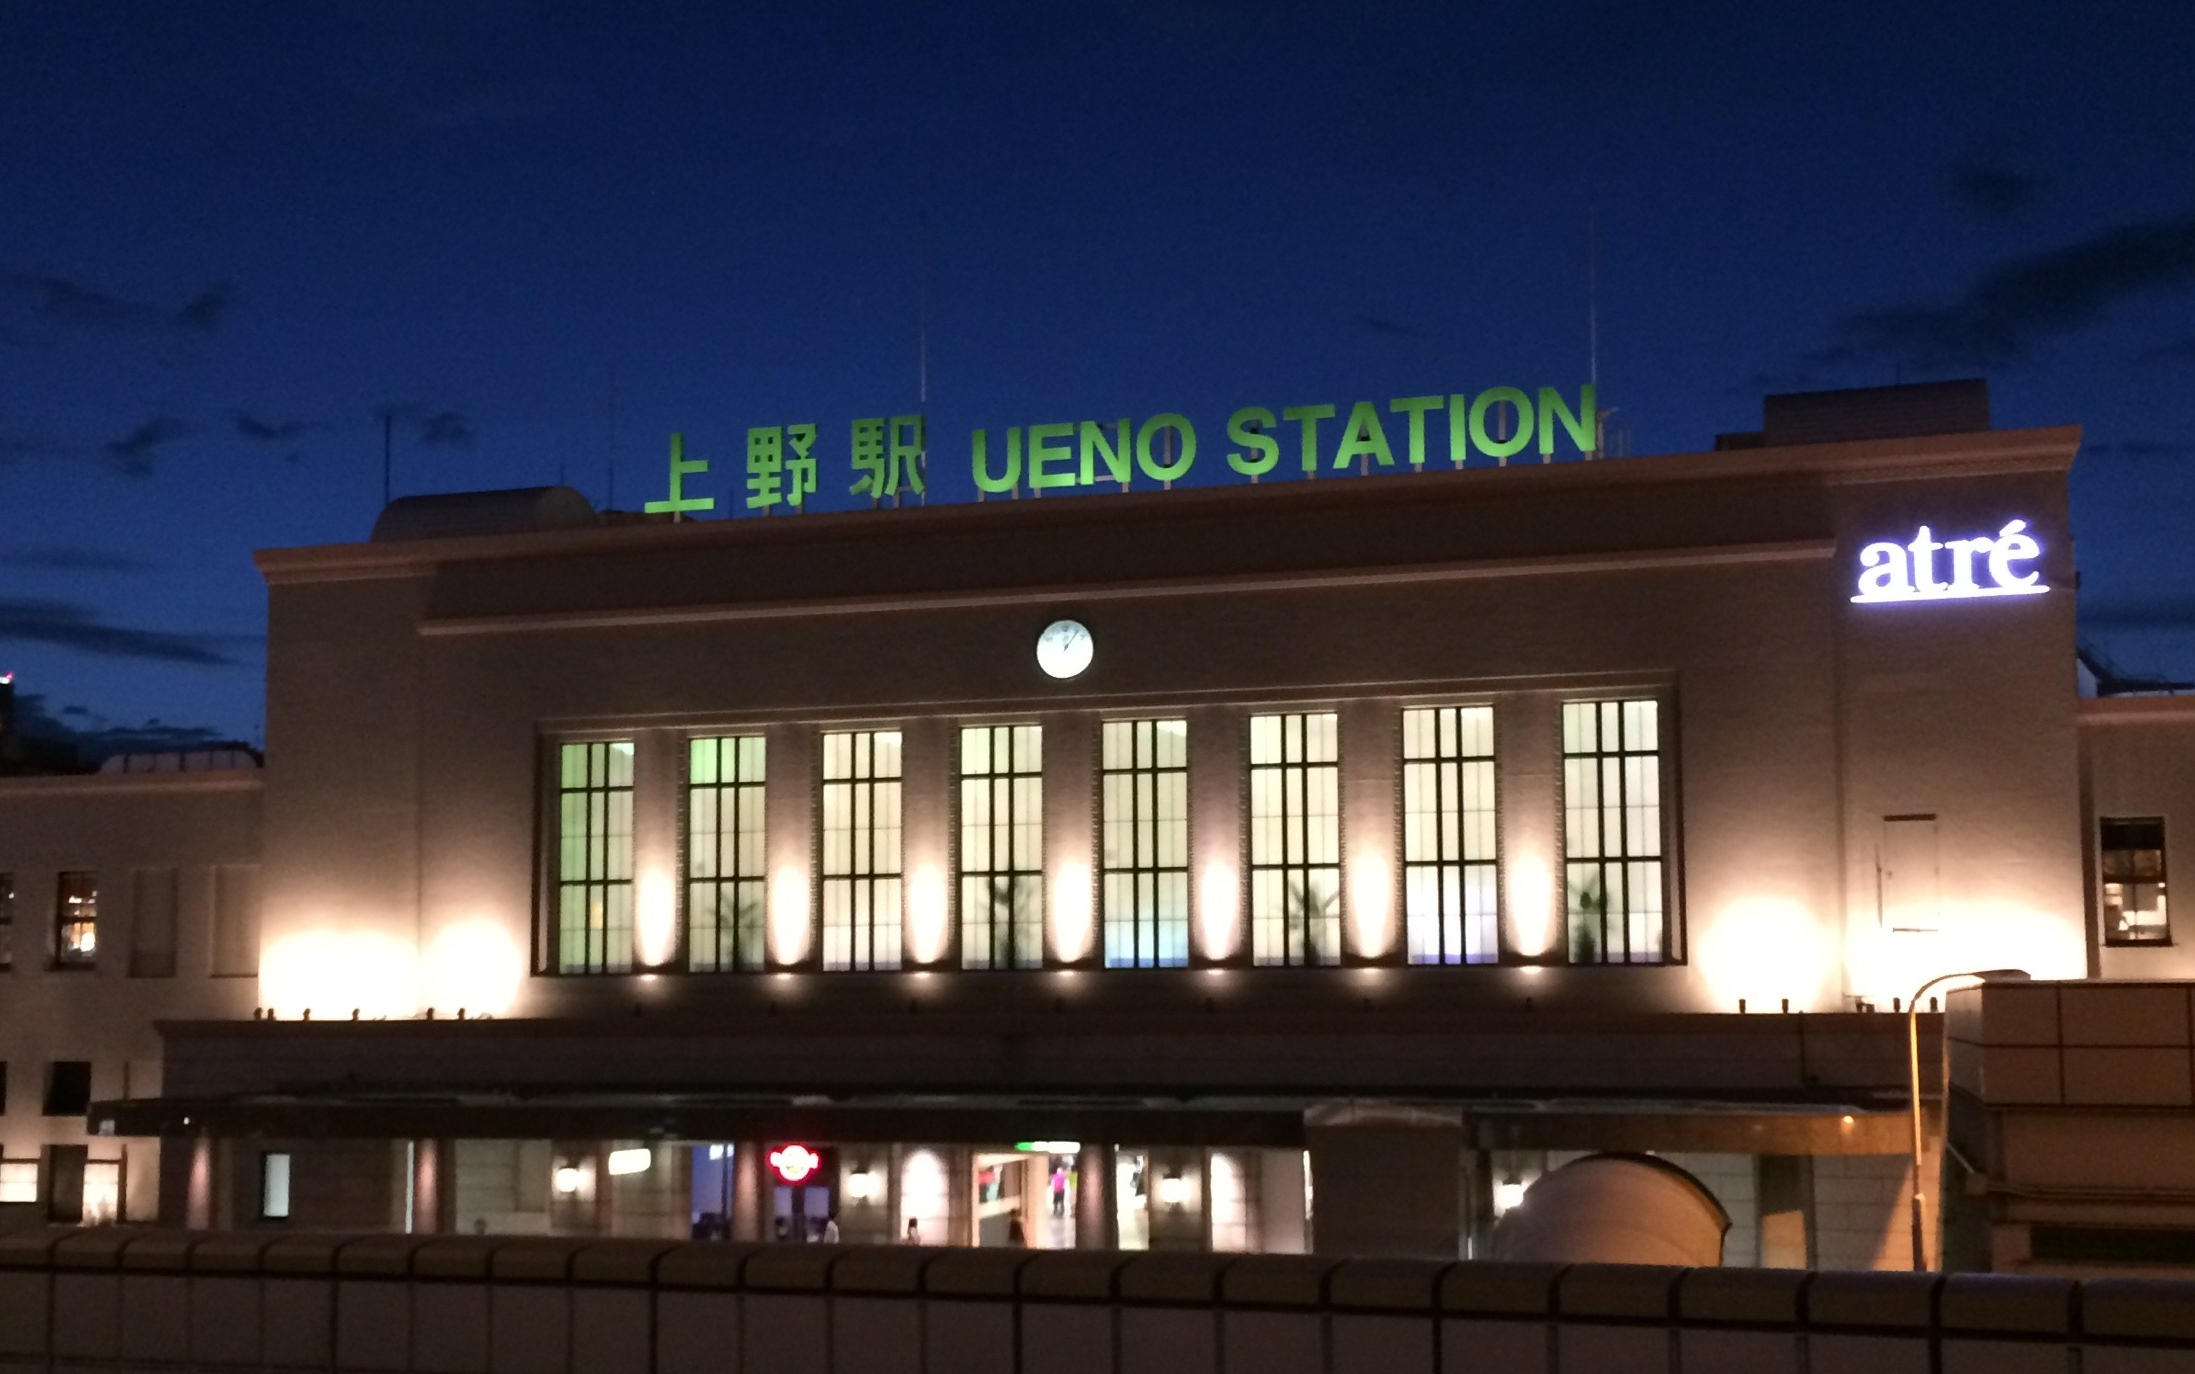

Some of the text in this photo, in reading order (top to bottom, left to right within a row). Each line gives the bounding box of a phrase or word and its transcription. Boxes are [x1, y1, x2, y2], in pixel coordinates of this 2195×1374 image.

[644, 384, 1596, 513] 上野駅 UENO STATION
[1857, 519, 2041, 596] atré
